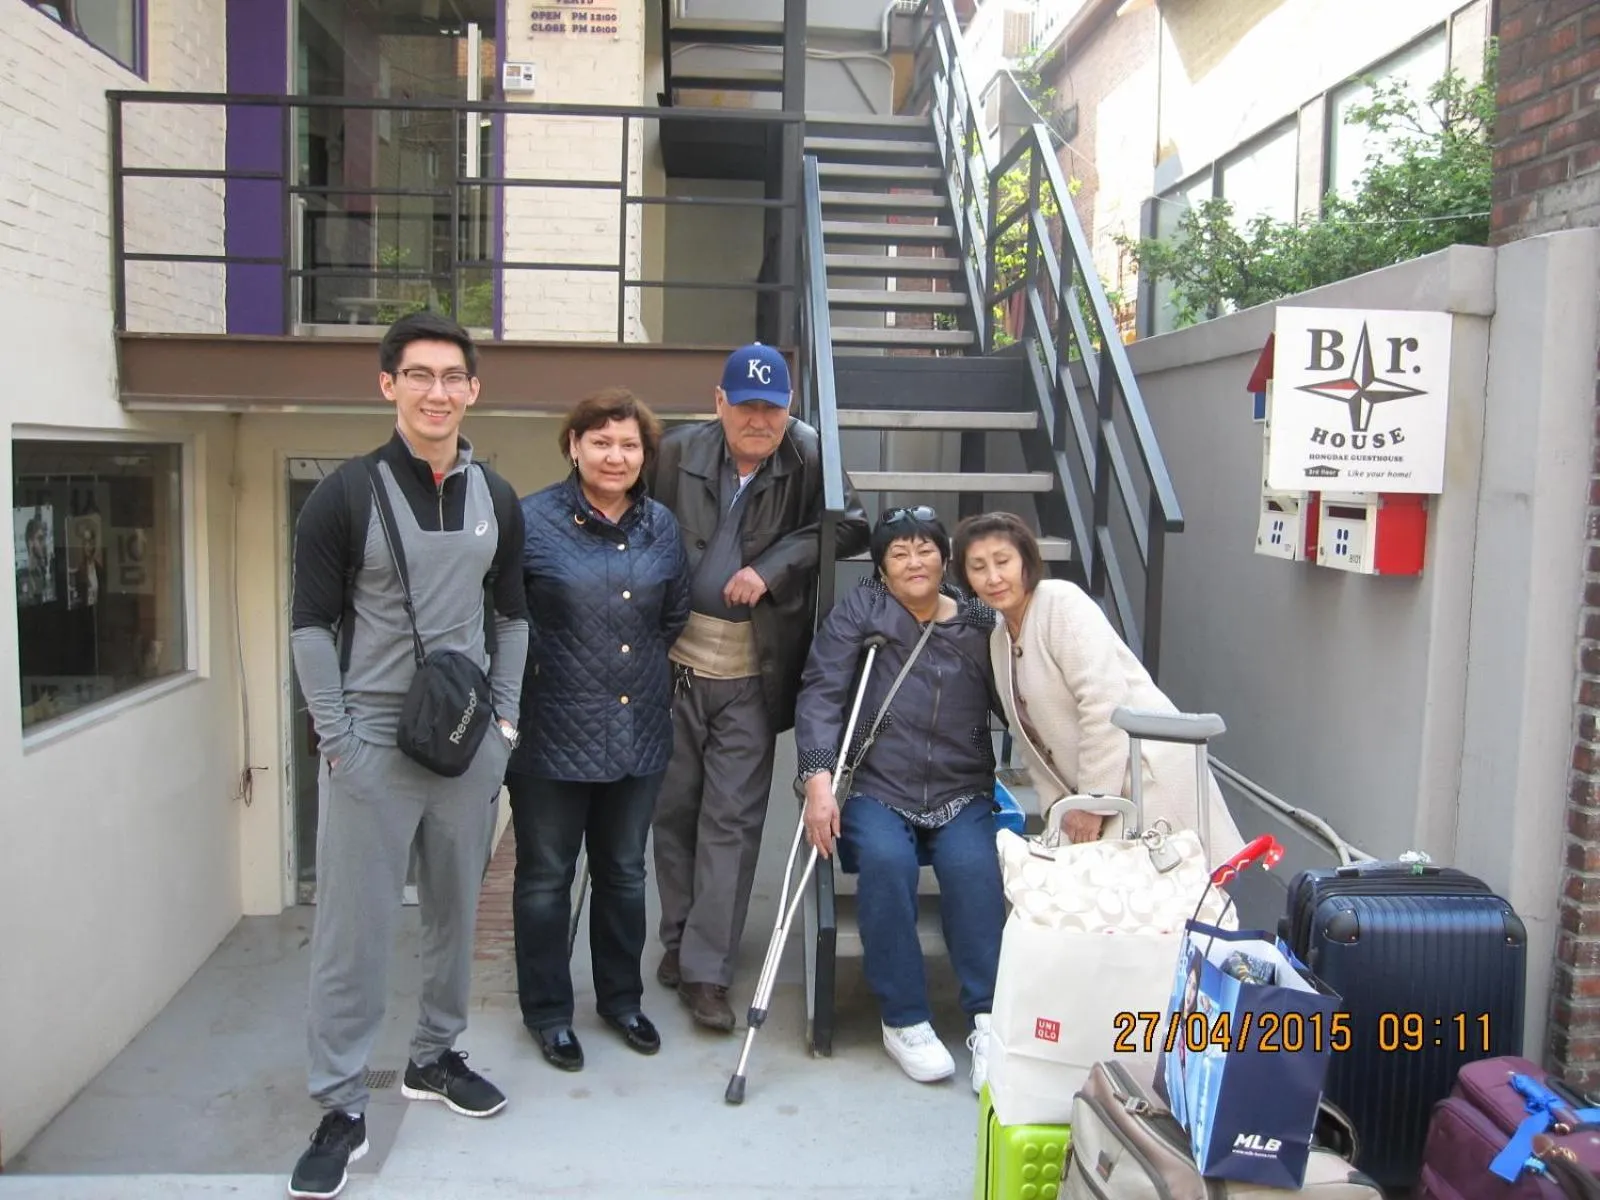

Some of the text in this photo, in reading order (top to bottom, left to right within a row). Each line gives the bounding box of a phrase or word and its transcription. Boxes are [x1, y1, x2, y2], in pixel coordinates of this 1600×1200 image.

[531, 11, 561, 20] OPEN
[571, 12, 587, 20] PM
[531, 23, 566, 32] CLOSE
[571, 24, 587, 33] PM
[747, 359, 771, 385] KC
[1309, 427, 1406, 450] HOUSE
[1308, 453, 1404, 463] HONGDAE GUESTHOUSE
[1387, 471, 1412, 479] home!
[449, 687, 477, 745] Reebok
[1039, 1020, 1056, 1031] UNI
[1038, 1029, 1057, 1040] QLO
[1233, 1133, 1282, 1151] MLB
